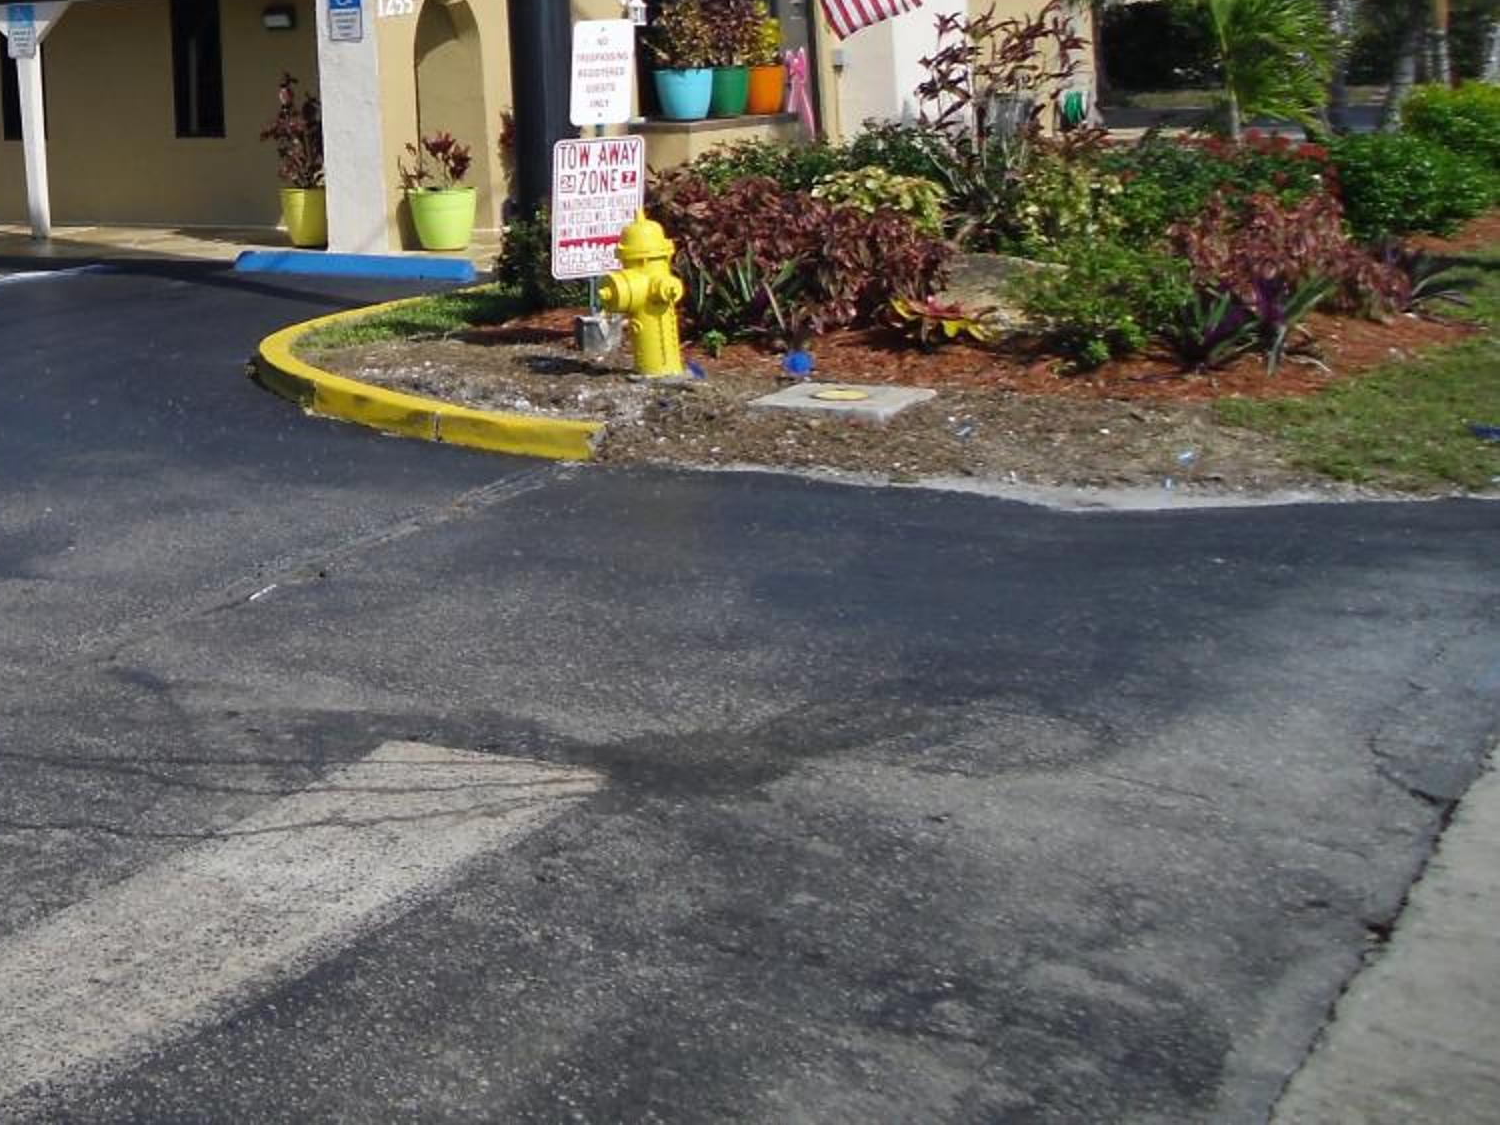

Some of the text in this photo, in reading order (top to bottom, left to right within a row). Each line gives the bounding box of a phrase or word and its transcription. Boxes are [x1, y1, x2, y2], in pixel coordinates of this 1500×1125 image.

[560, 142, 639, 170] TOW AWAY
[578, 169, 619, 195] ZONE
